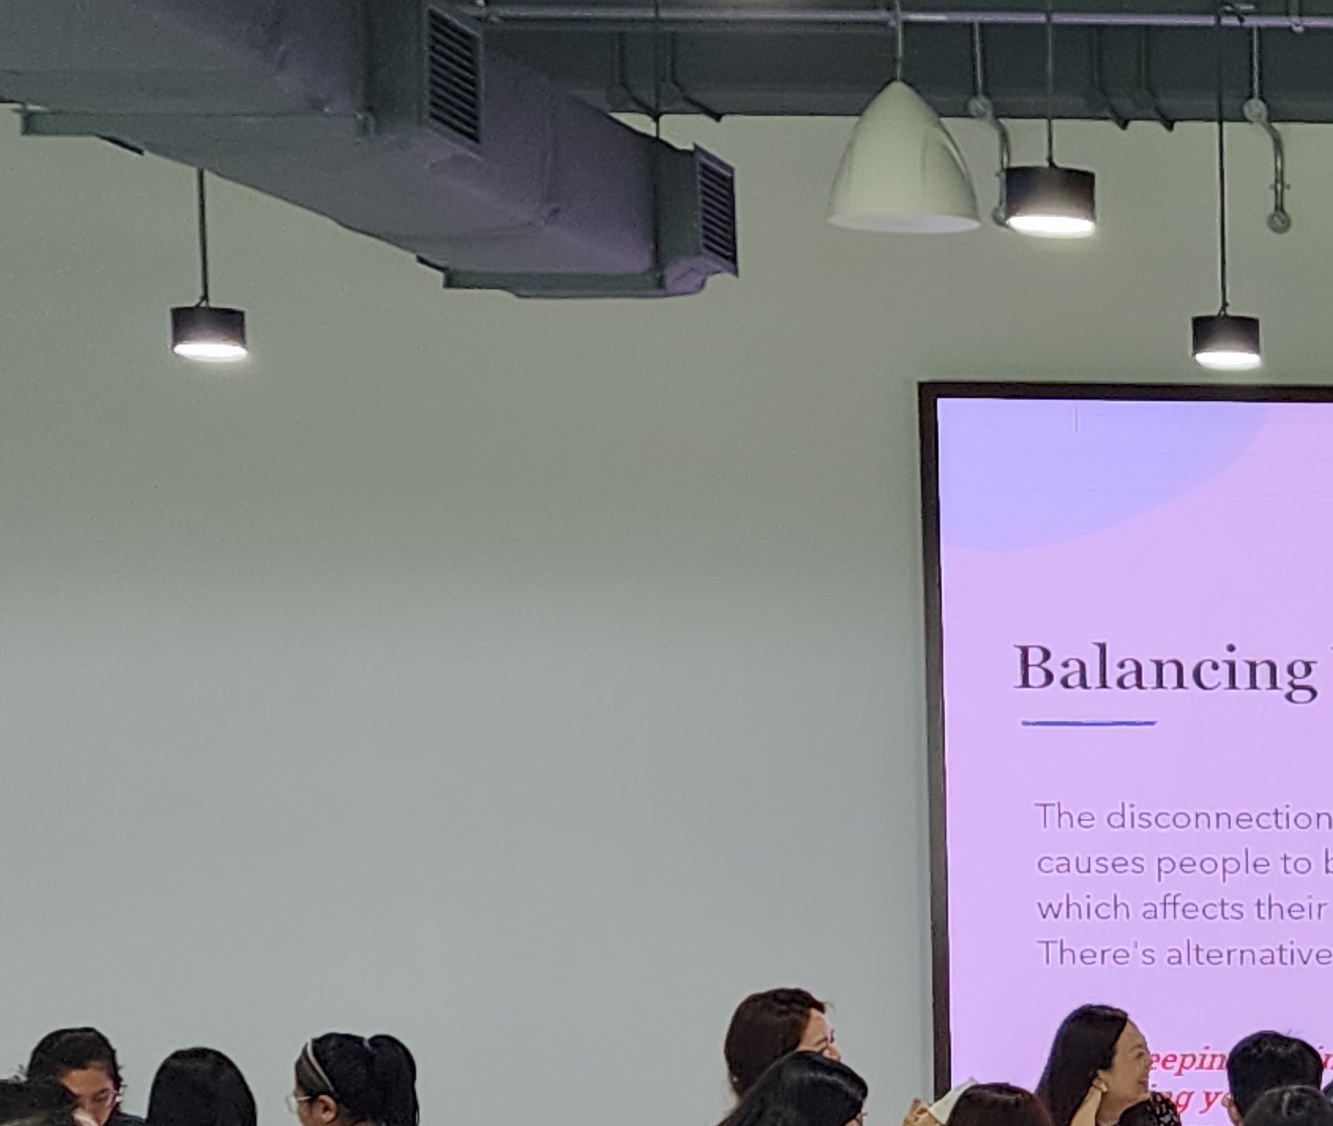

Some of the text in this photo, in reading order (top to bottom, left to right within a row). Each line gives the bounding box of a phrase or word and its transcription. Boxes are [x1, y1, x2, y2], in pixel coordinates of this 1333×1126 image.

[1014, 641, 1319, 705] Balancing
[1034, 801, 1096, 831] The
[1106, 801, 1333, 831] disconnection
[1037, 853, 1145, 876] causes
[1157, 847, 1271, 884] people
[1279, 850, 1312, 876] to
[1036, 892, 1130, 921] which
[1141, 892, 1244, 921] affects
[1254, 893, 1329, 921] their
[1036, 938, 1156, 966] There's
[1166, 938, 1333, 967] alternative
[1149, 1046, 1227, 1076] eepin
